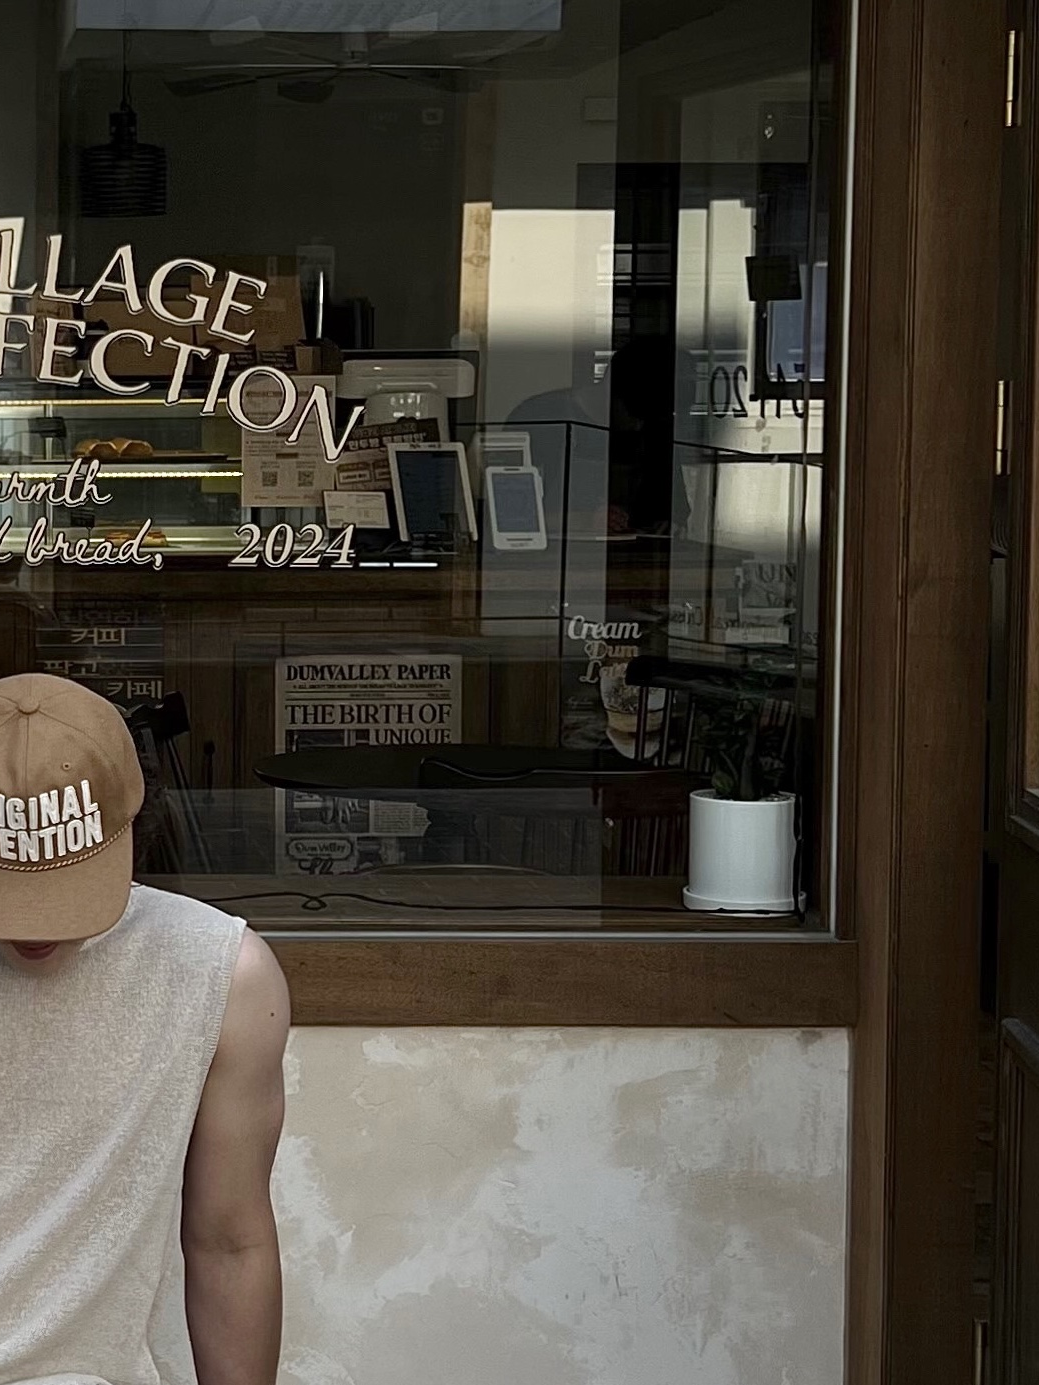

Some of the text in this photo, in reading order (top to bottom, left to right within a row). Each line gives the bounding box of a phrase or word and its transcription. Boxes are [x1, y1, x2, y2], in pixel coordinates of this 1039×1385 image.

[25, 518, 165, 571] bread,
[228, 523, 357, 569] 2024
[70, 627, 126, 646] 커피
[568, 615, 642, 640] Cream
[286, 664, 451, 681] DUMVALLEY PAPER
[107, 680, 163, 699] 카페
[285, 704, 452, 724] THE BIRTH OF
[375, 728, 451, 745] UNIQUE
